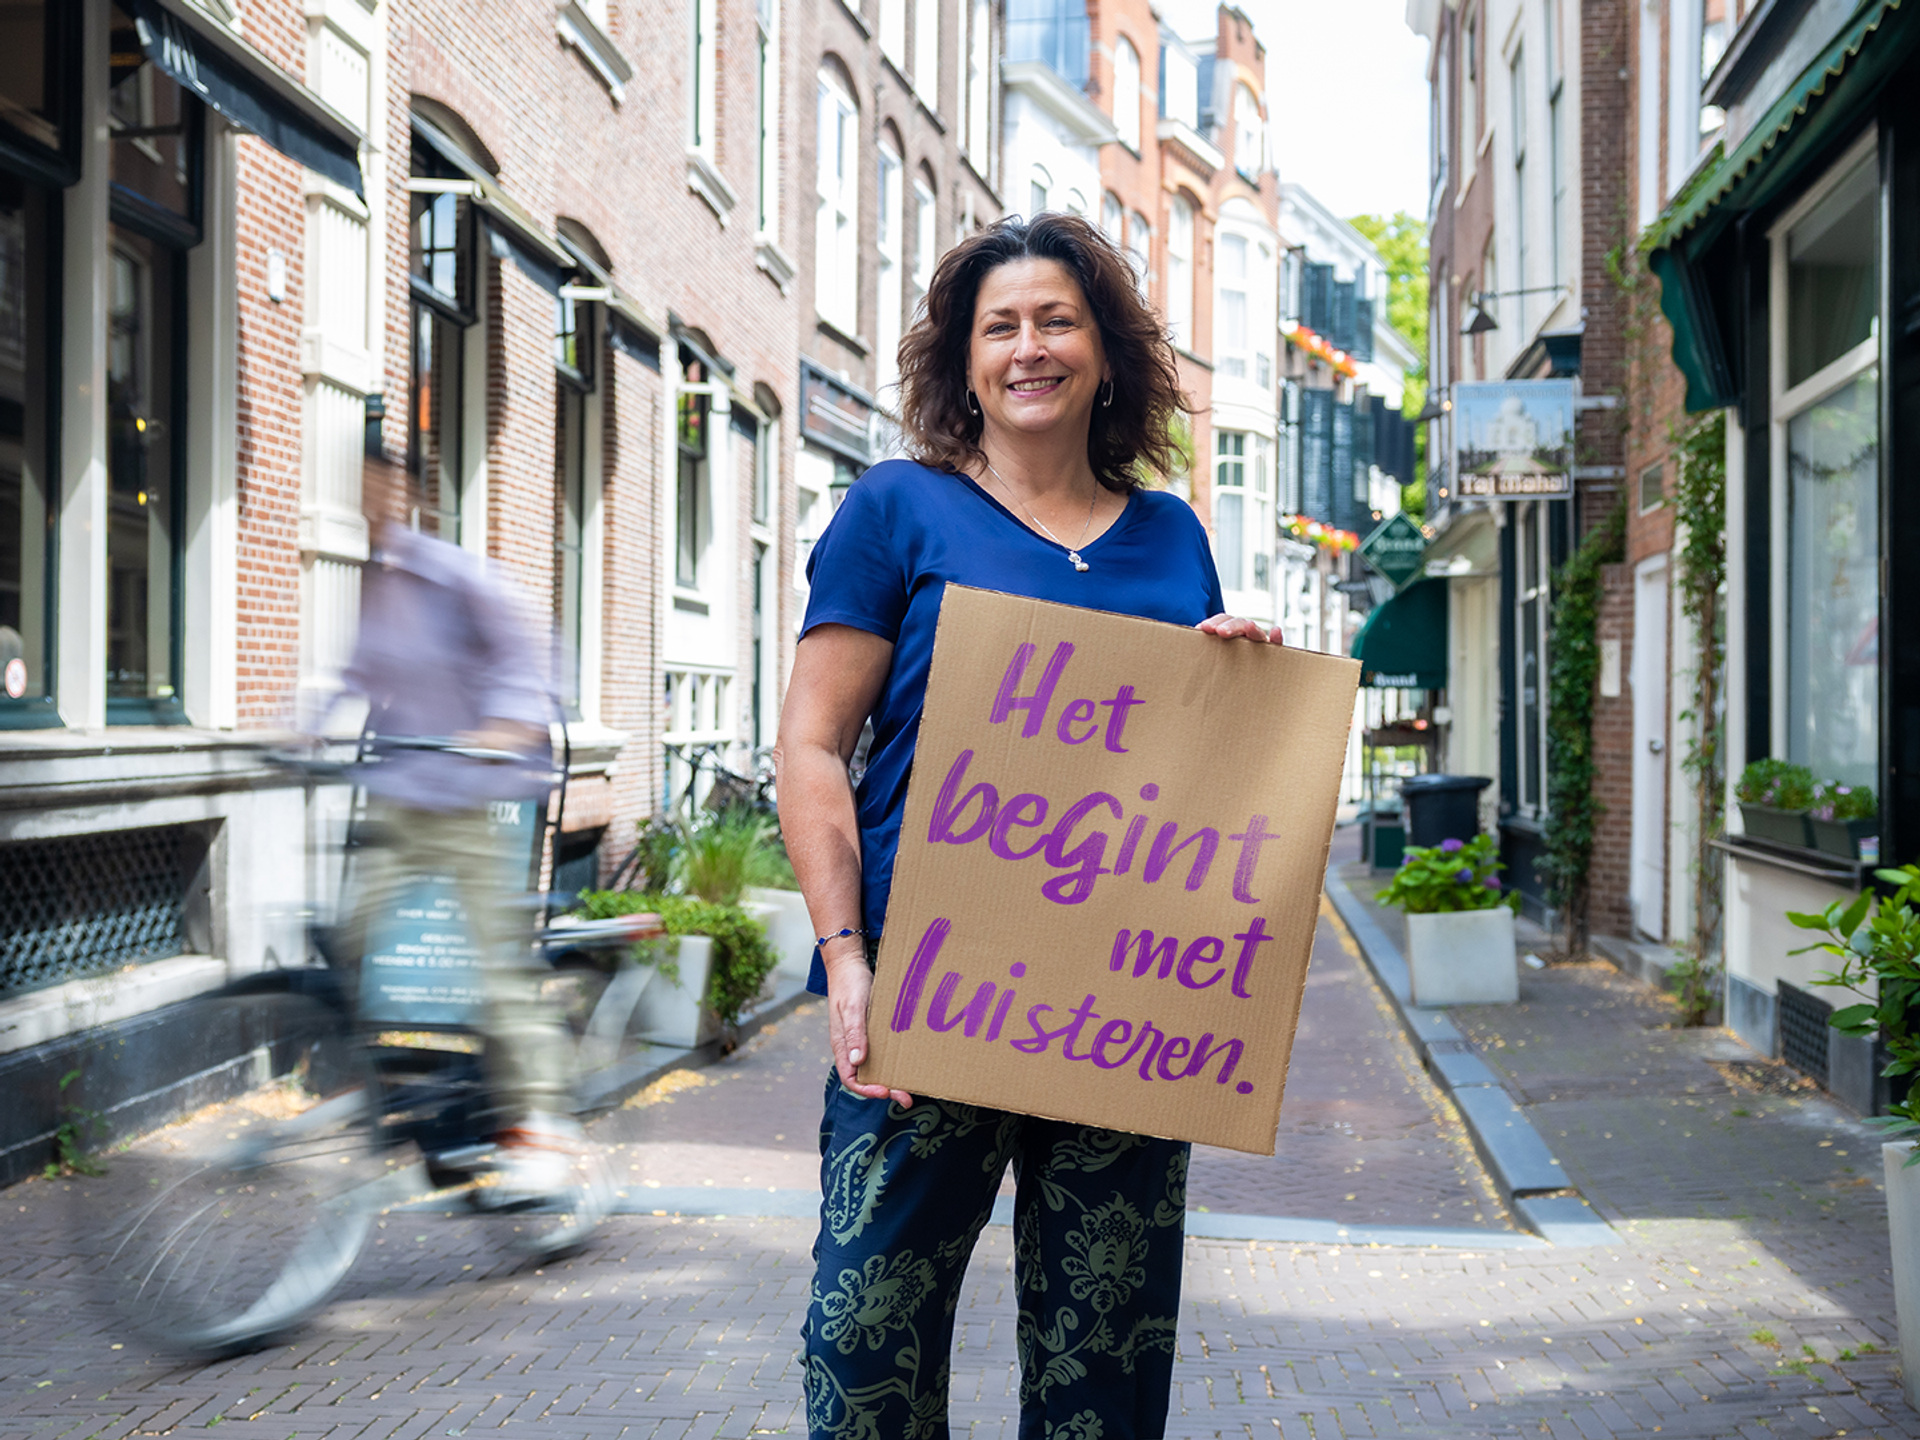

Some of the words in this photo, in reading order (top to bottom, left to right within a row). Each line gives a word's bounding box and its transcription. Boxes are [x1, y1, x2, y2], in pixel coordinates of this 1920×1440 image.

[1460, 473, 1496, 496] Taj
[989, 641, 1146, 753] Het
[927, 749, 1281, 905] begint
[891, 917, 1254, 1094] luisteren.
[1109, 917, 1273, 999] met
